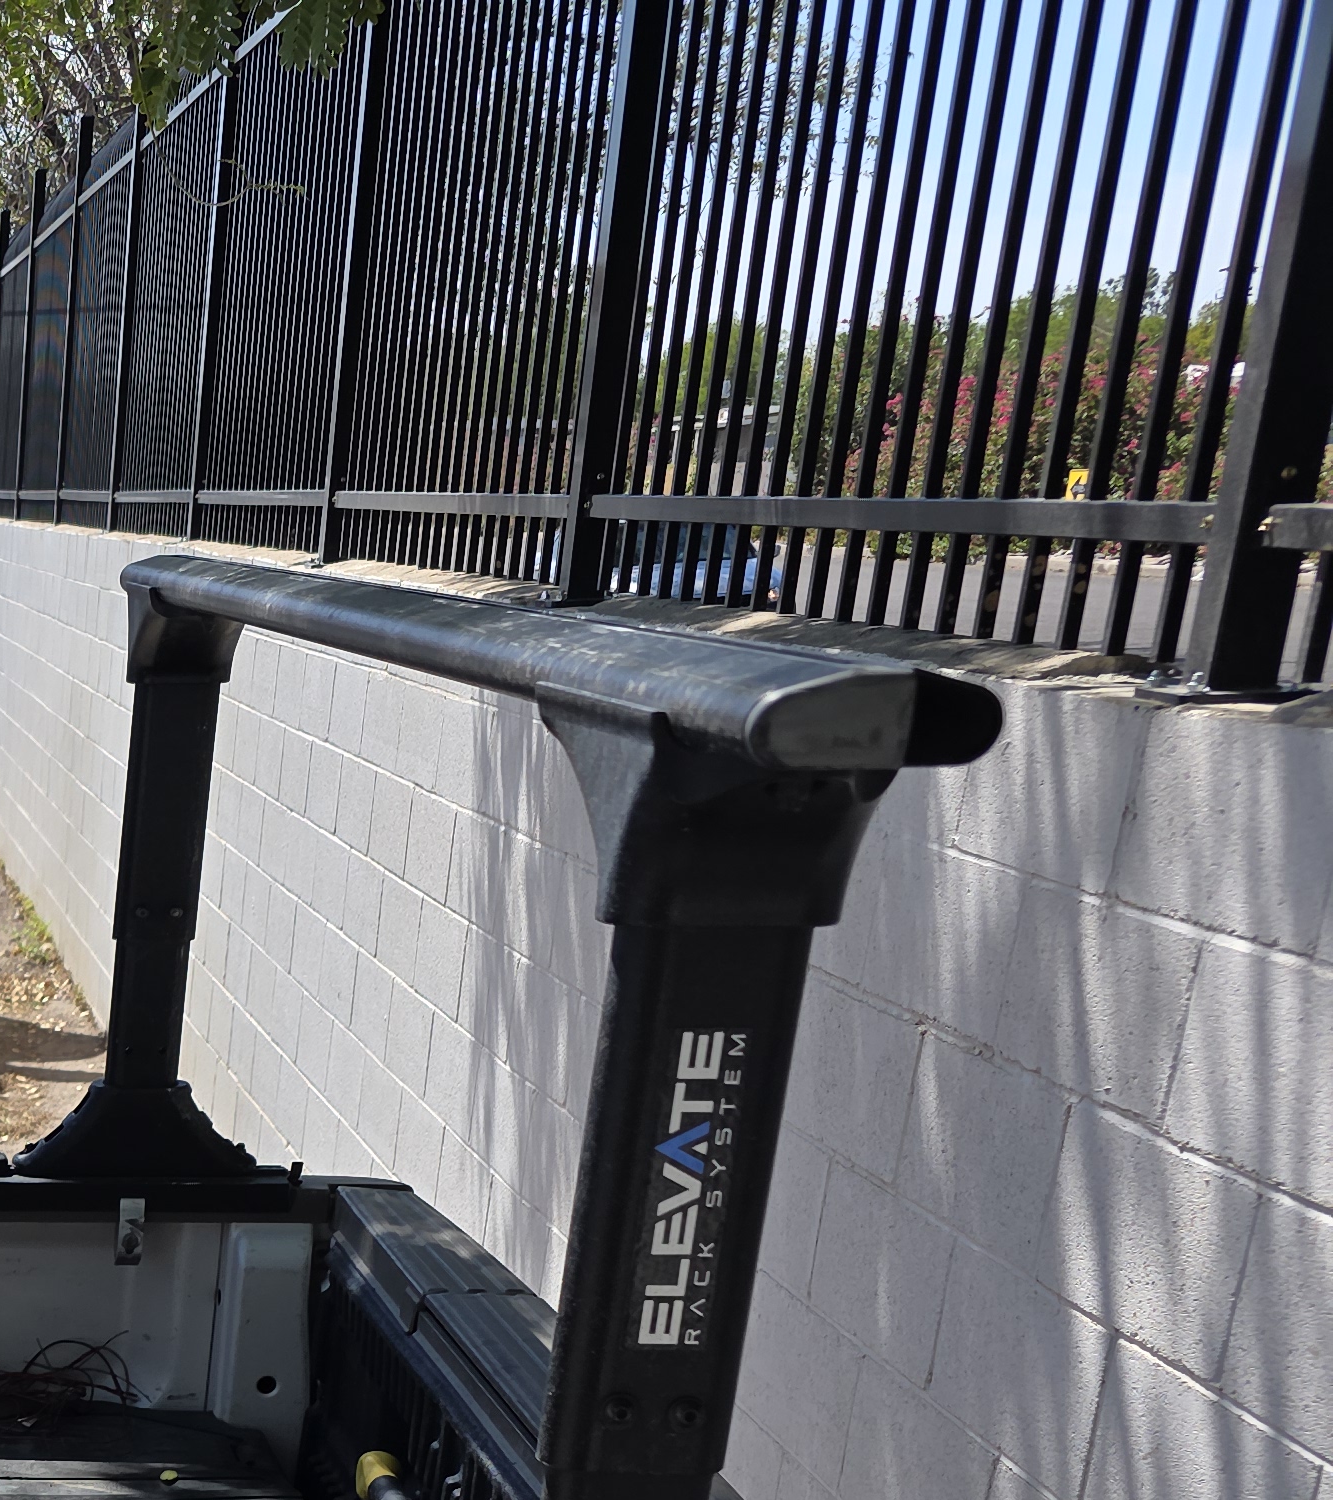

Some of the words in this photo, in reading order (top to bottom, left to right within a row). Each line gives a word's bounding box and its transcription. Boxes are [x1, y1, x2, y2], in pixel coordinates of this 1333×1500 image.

[638, 1031, 725, 1345] ELEVATE
[684, 1242, 716, 1345] RACK
[705, 1033, 747, 1208] SYSTEM
